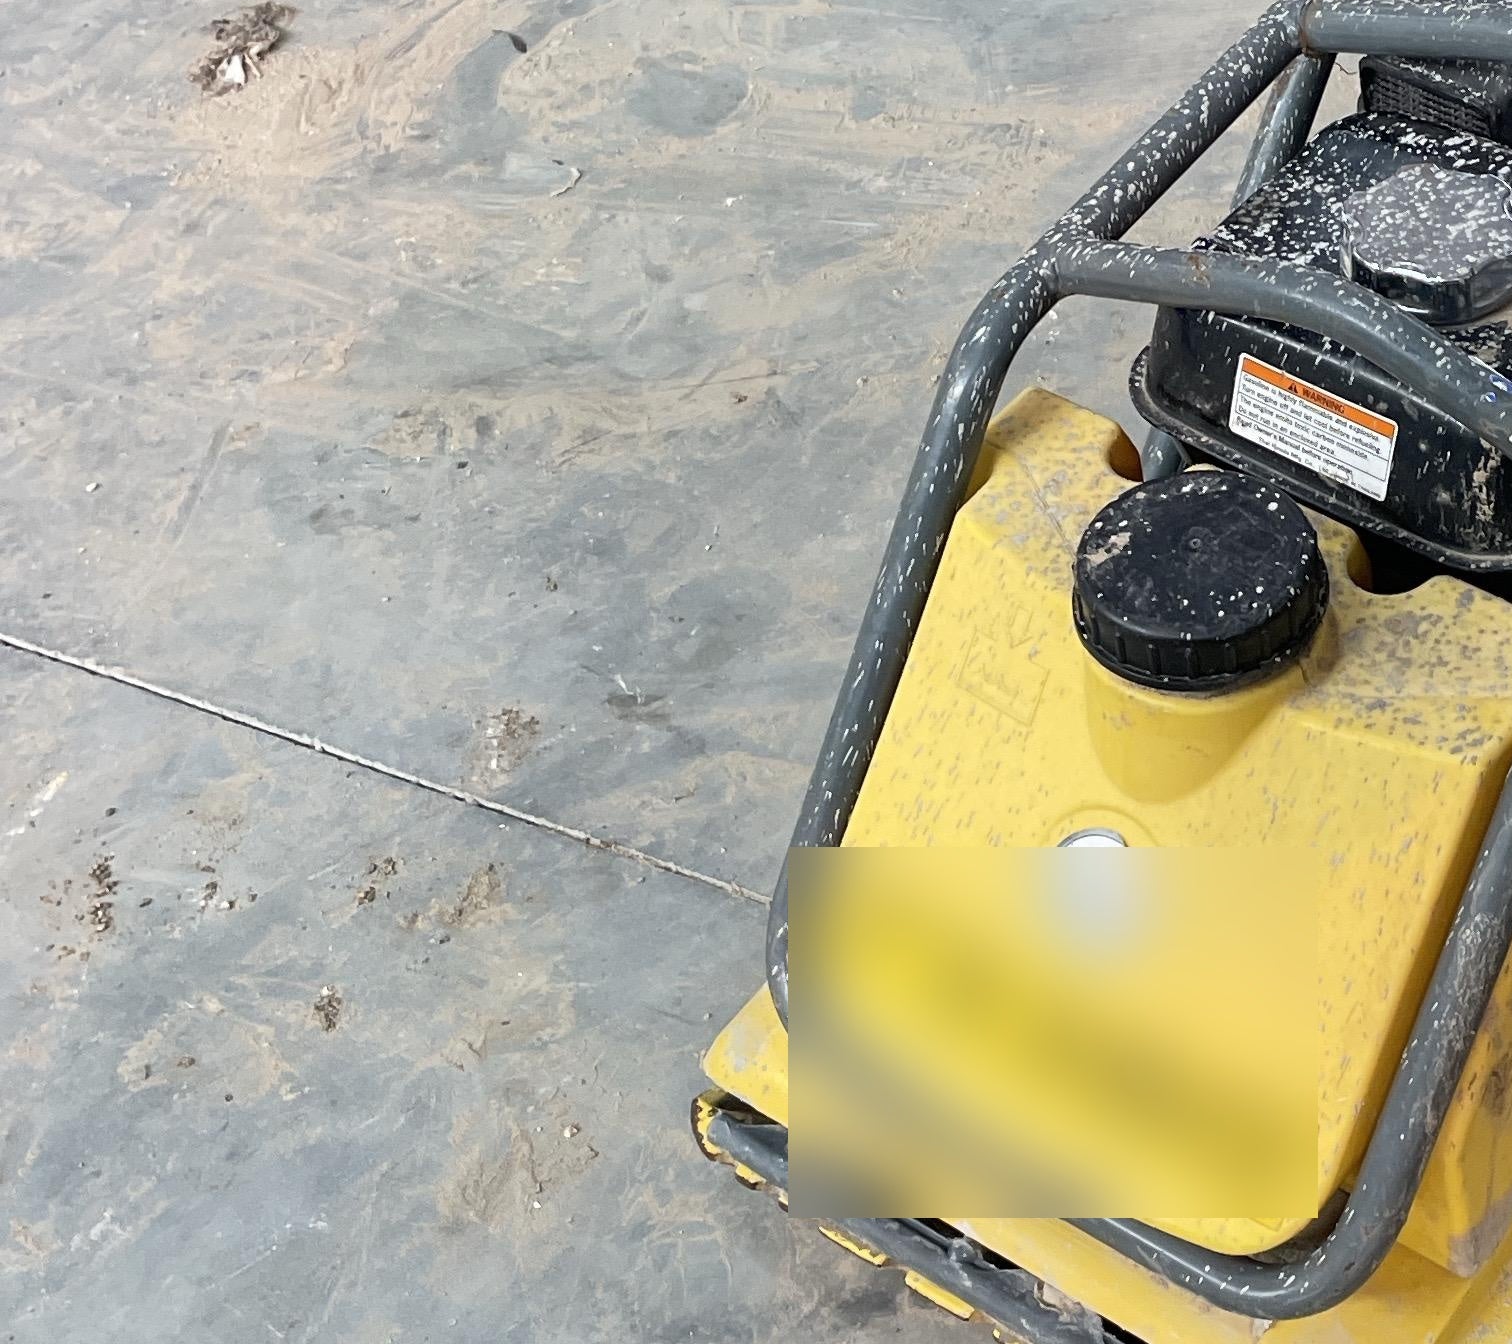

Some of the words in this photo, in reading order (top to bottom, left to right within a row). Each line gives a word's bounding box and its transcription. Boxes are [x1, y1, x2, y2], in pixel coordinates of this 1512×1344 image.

[1243, 373, 1269, 391] Gasoline
[1277, 390, 1296, 405] highly
[1301, 387, 1345, 414] WARNING
[1241, 383, 1256, 395] Turn
[1256, 391, 1277, 406] engine
[1328, 424, 1350, 439] before
[1252, 402, 1273, 417] engine
[1311, 430, 1334, 444] carbon
[1278, 435, 1300, 450] Manual
[1301, 447, 1321, 460] before
